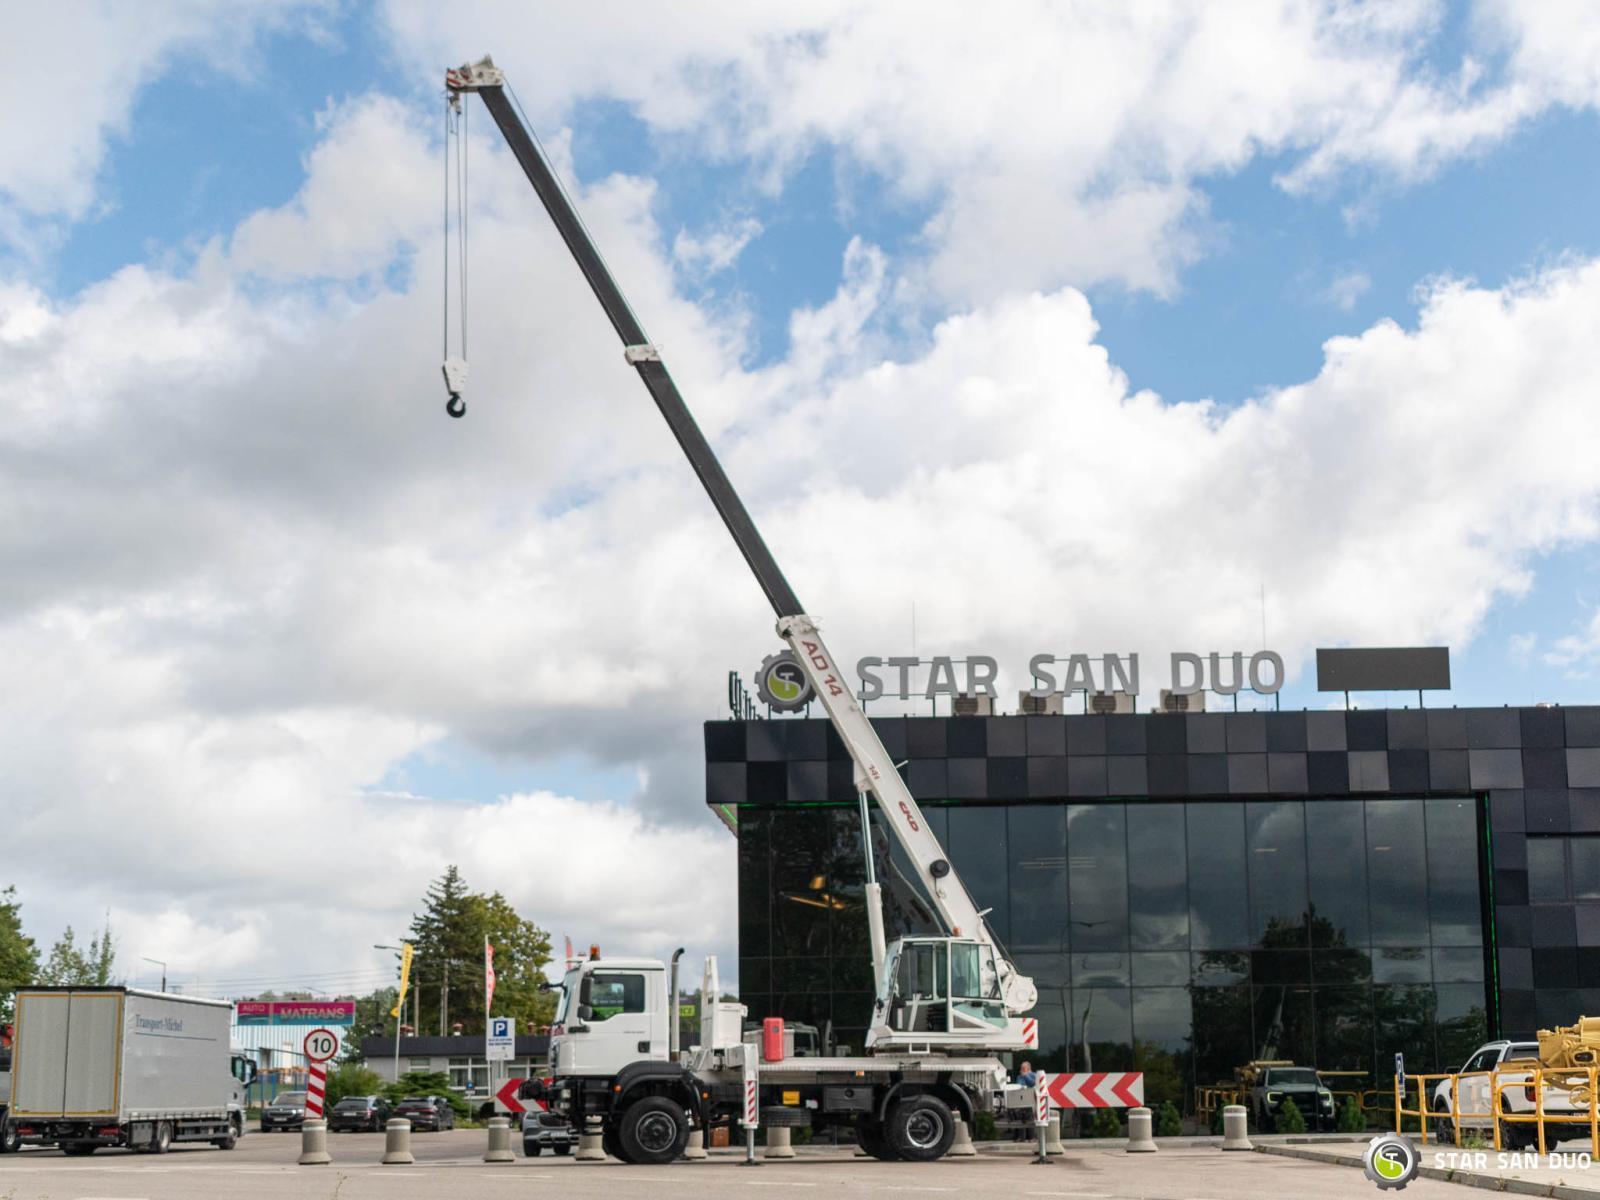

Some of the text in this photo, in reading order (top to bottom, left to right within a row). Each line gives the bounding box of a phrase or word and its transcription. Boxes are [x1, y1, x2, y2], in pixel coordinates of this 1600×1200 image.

[801, 640, 843, 697] AD 14
[856, 650, 1284, 700] STAR SAN DUO
[242, 1004, 345, 1020] AUTO MATRANS
[495, 1022, 506, 1036] P
[312, 1038, 331, 1054] 10
